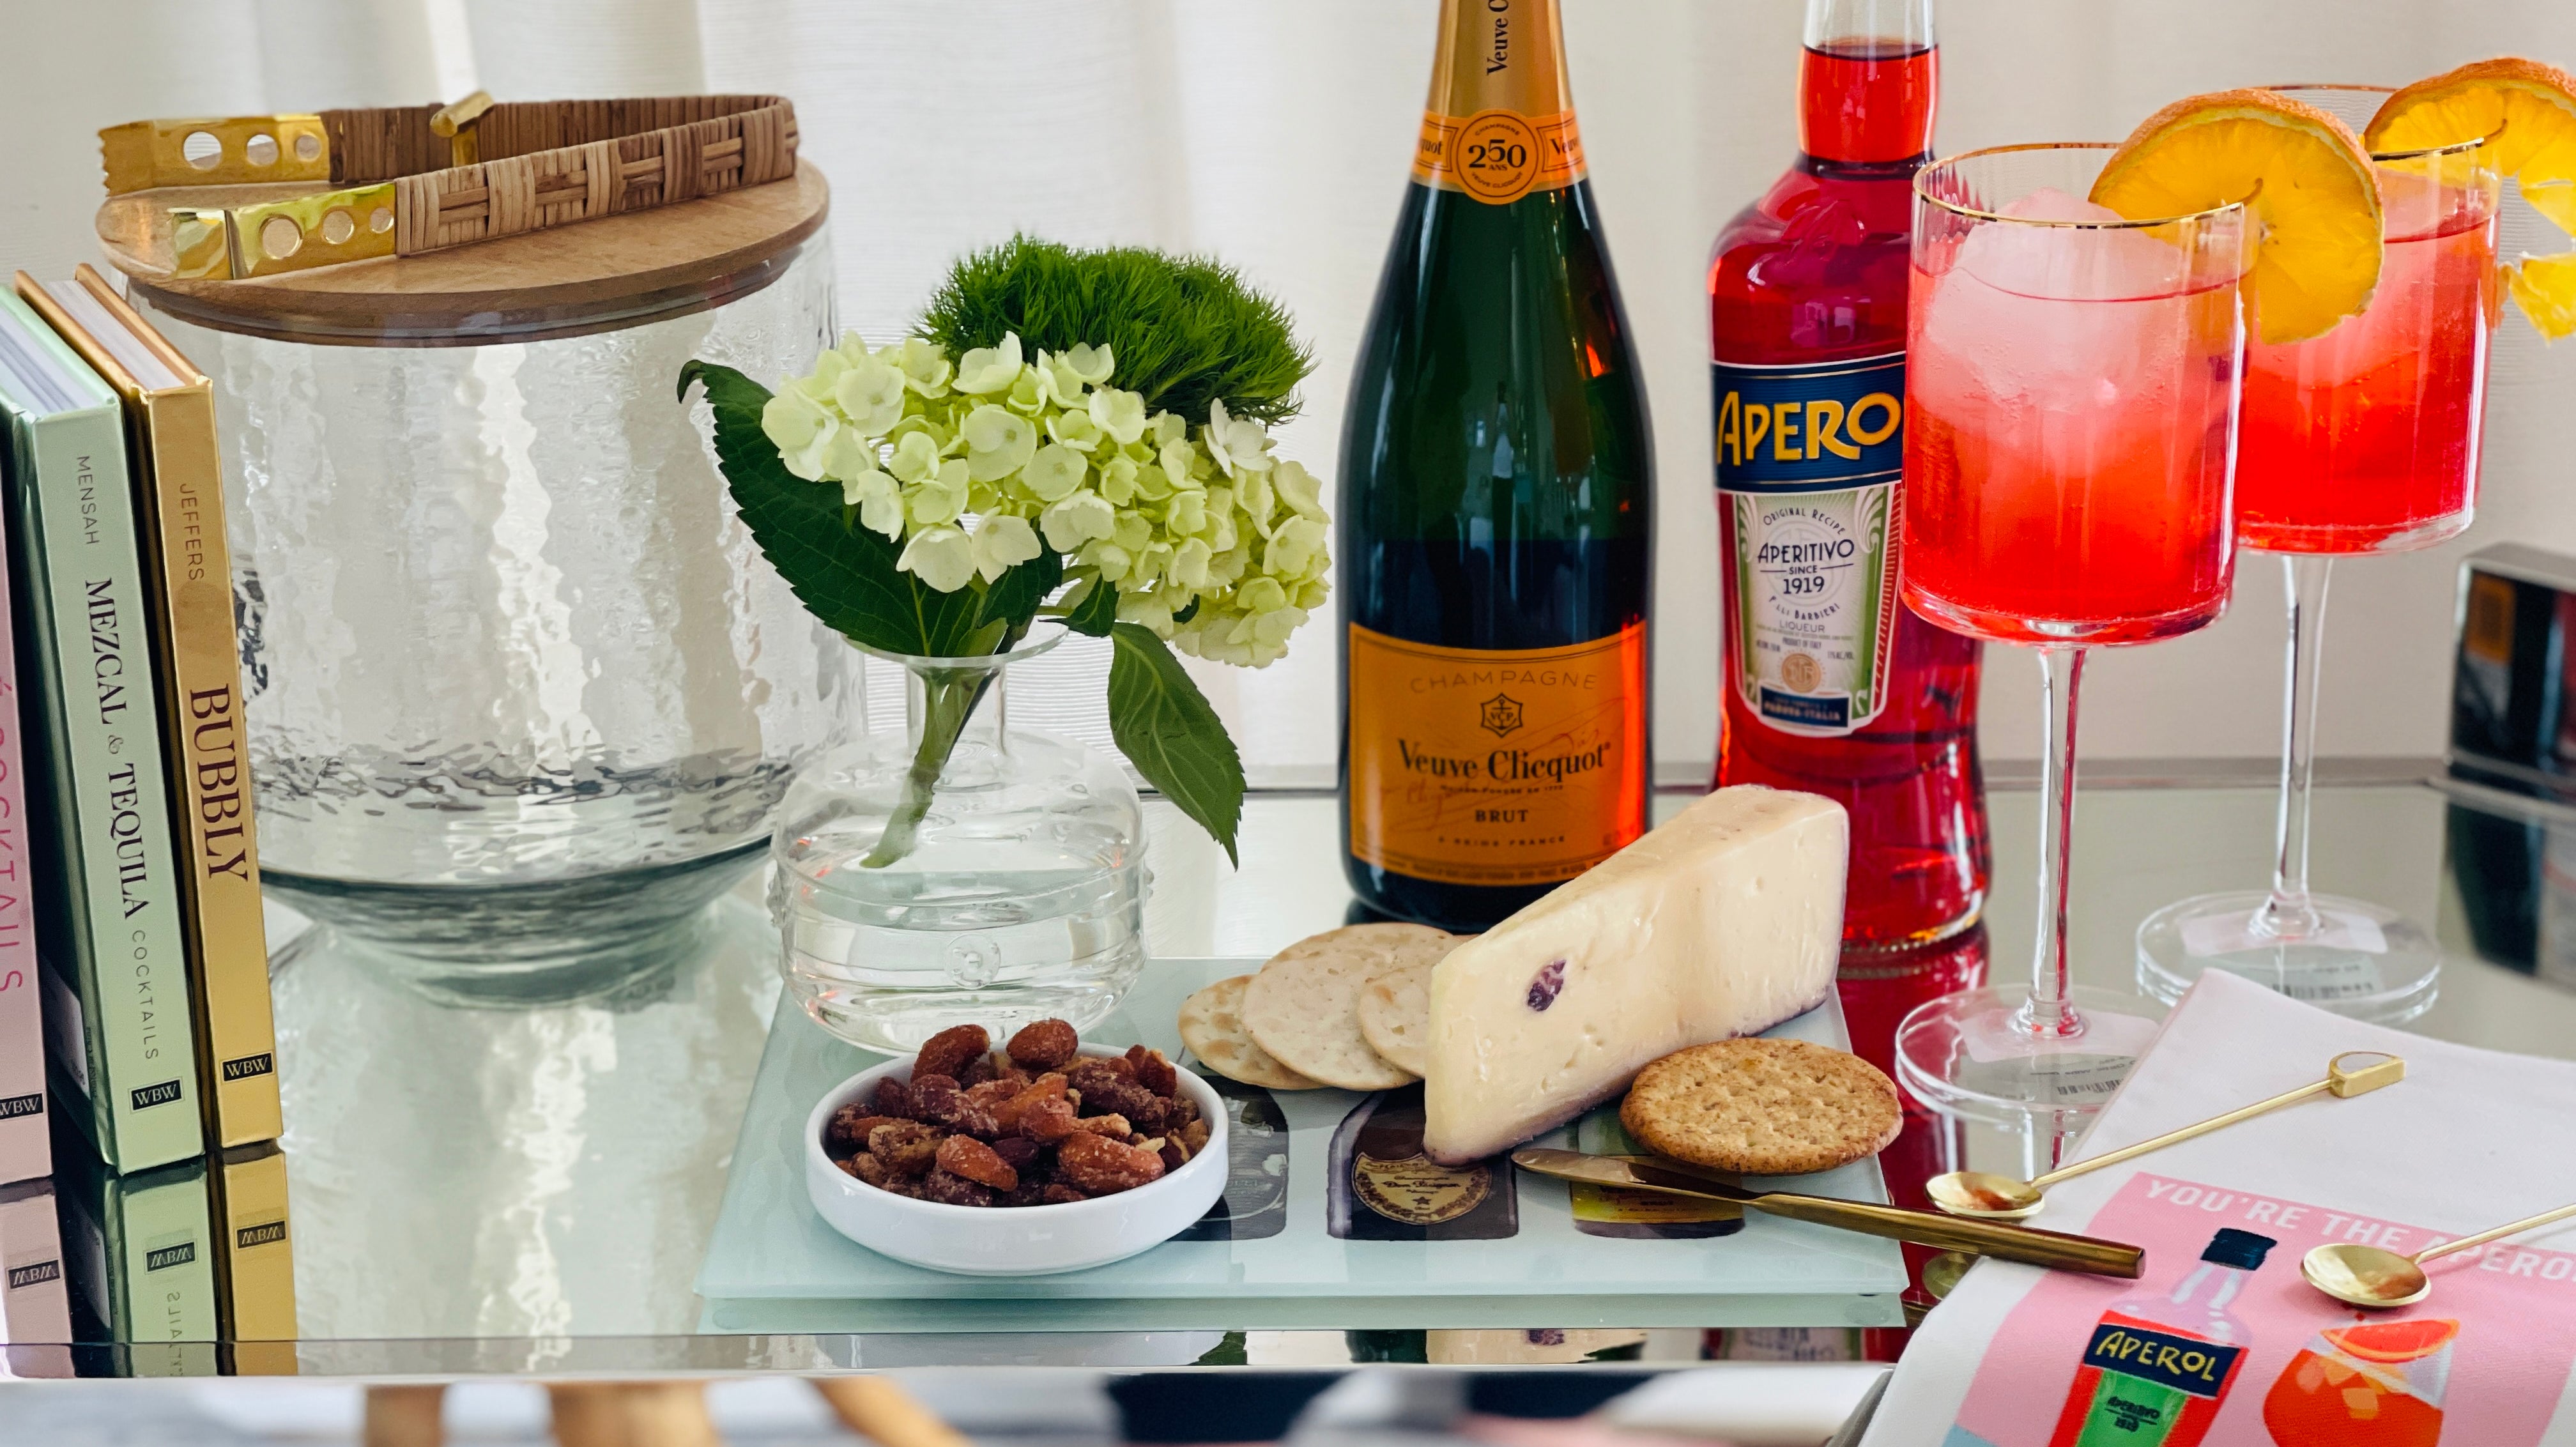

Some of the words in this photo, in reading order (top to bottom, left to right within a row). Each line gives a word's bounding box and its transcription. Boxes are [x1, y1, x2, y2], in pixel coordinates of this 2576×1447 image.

[1487, 18, 1508, 75] Veuve
[1468, 139, 1527, 168] 250
[77, 455, 100, 545] MENSAH
[179, 483, 204, 581] JEFFERS
[1763, 507, 1806, 526] ORIGINAL
[1812, 509, 1846, 535] RECIPE
[1757, 539, 1855, 563] APERITIVO
[1789, 565, 1818, 575] SINCE
[1783, 576, 1825, 595] 1919
[1795, 602, 1841, 620] BARBIERI
[1779, 620, 1825, 633] LIQUEUR
[85, 577, 127, 725] MEZCAL
[1410, 670, 1597, 694] CHAMPAGNE
[107, 734, 123, 754] &
[1398, 739, 1478, 780] Veuve
[190, 683, 249, 882] BUBBLY
[1475, 809, 1529, 823] BRUT
[108, 762, 150, 919] TEQUILA
[132, 930, 158, 1059] COCKTAILS
[226, 1056, 268, 1077] WBW
[134, 1083, 177, 1106] WBW
[2146, 1179, 2310, 1230] YOU'RE
[2321, 1213, 2411, 1250] THE
[2095, 1330, 2216, 1381] APEROL
